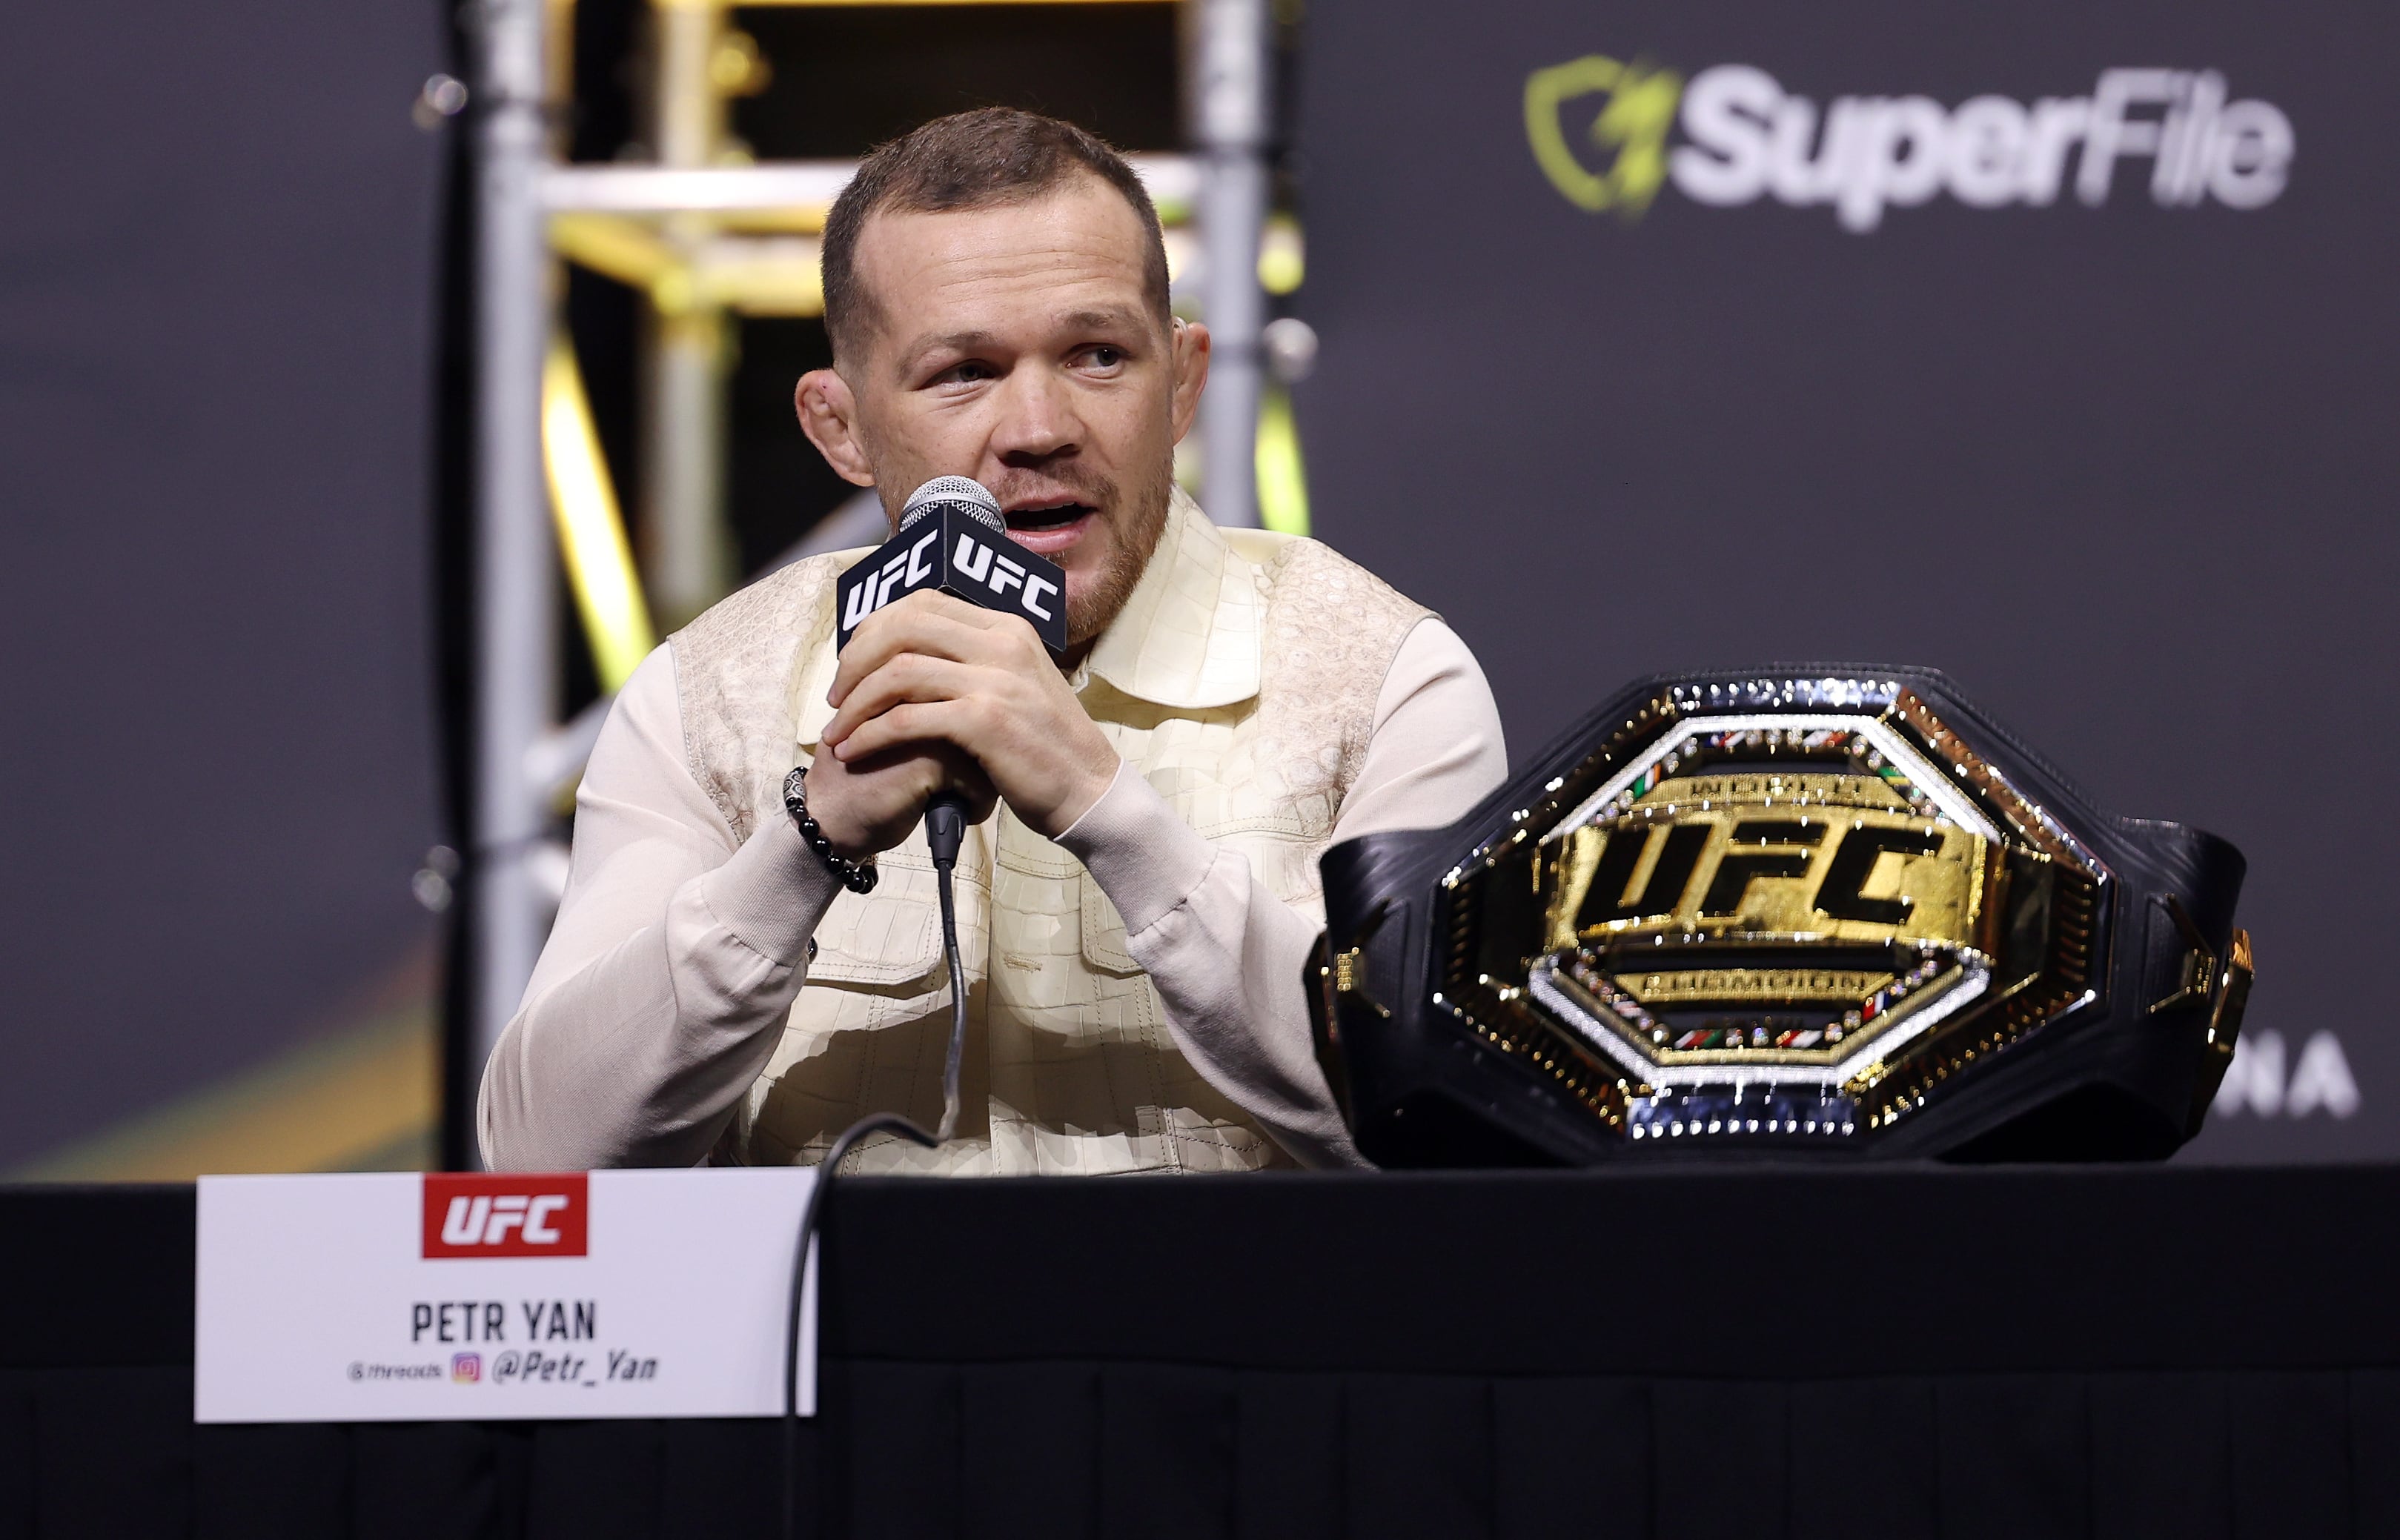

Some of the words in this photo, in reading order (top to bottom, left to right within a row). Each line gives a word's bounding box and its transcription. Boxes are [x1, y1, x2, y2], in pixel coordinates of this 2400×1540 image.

[1669, 64, 2295, 233] SuperFile
[843, 528, 938, 631] UFC
[952, 533, 1058, 622] UFC
[1574, 820, 1946, 926] UFC
[441, 1195, 568, 1245] UFC
[412, 1302, 505, 1342] PETR
[523, 1300, 595, 1341] YAN
[491, 1350, 658, 1387] @Petr_Yan
